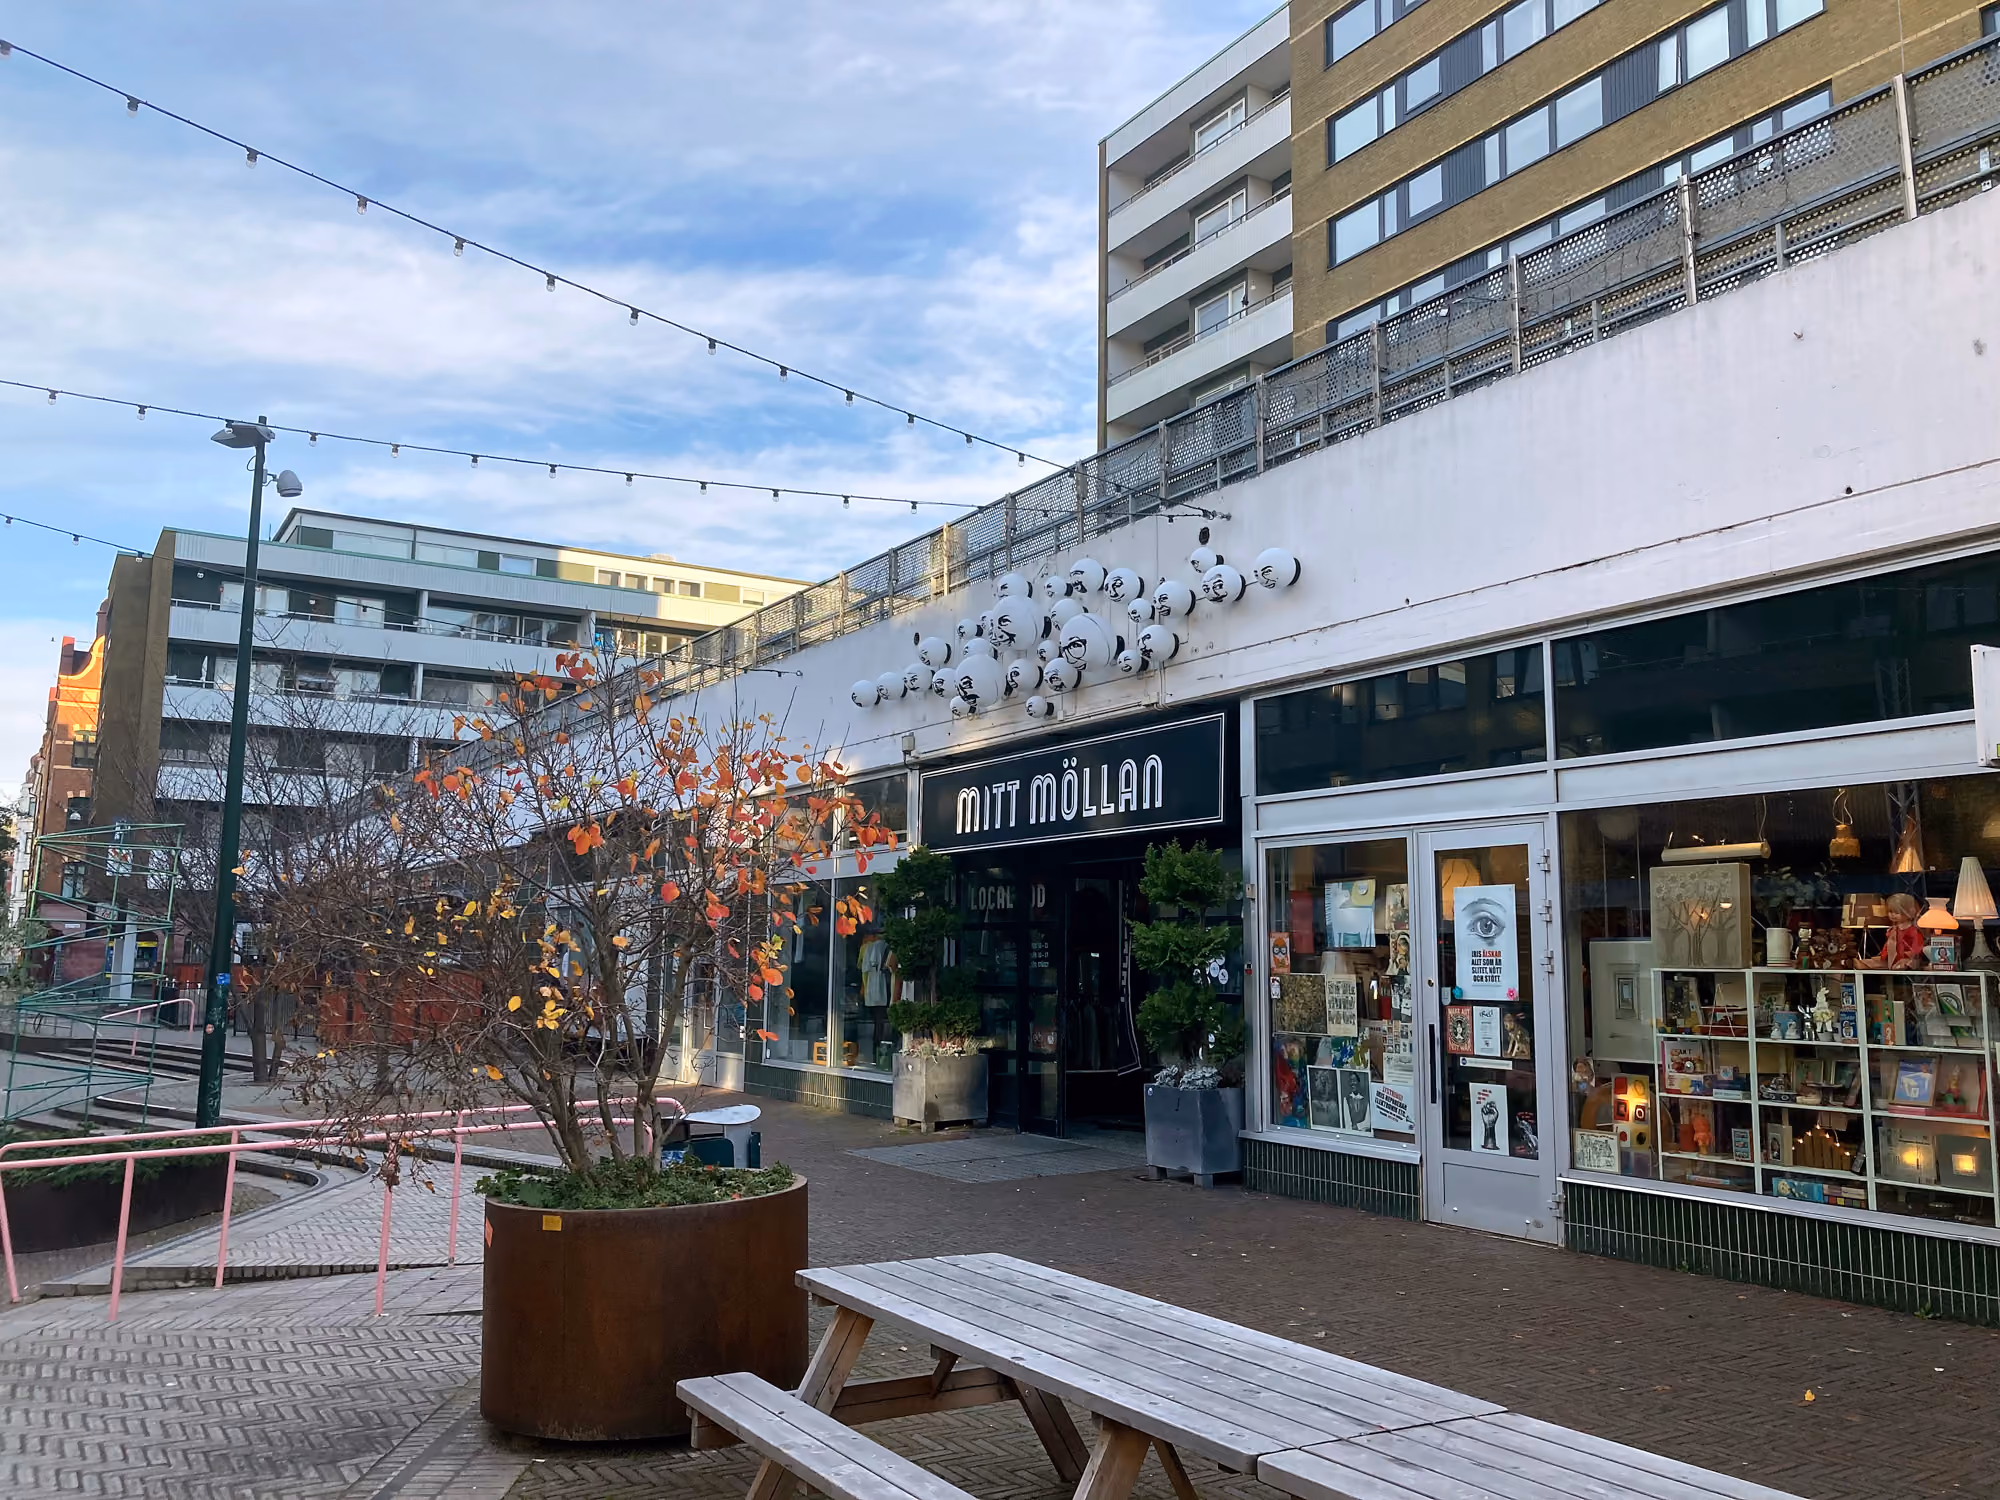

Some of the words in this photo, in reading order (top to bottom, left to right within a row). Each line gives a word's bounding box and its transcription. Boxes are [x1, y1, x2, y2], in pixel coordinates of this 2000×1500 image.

[956, 780, 1020, 834] MITT
[1029, 754, 1163, 824] MÖLLAN
[970, 885, 1014, 910] LOCAL
